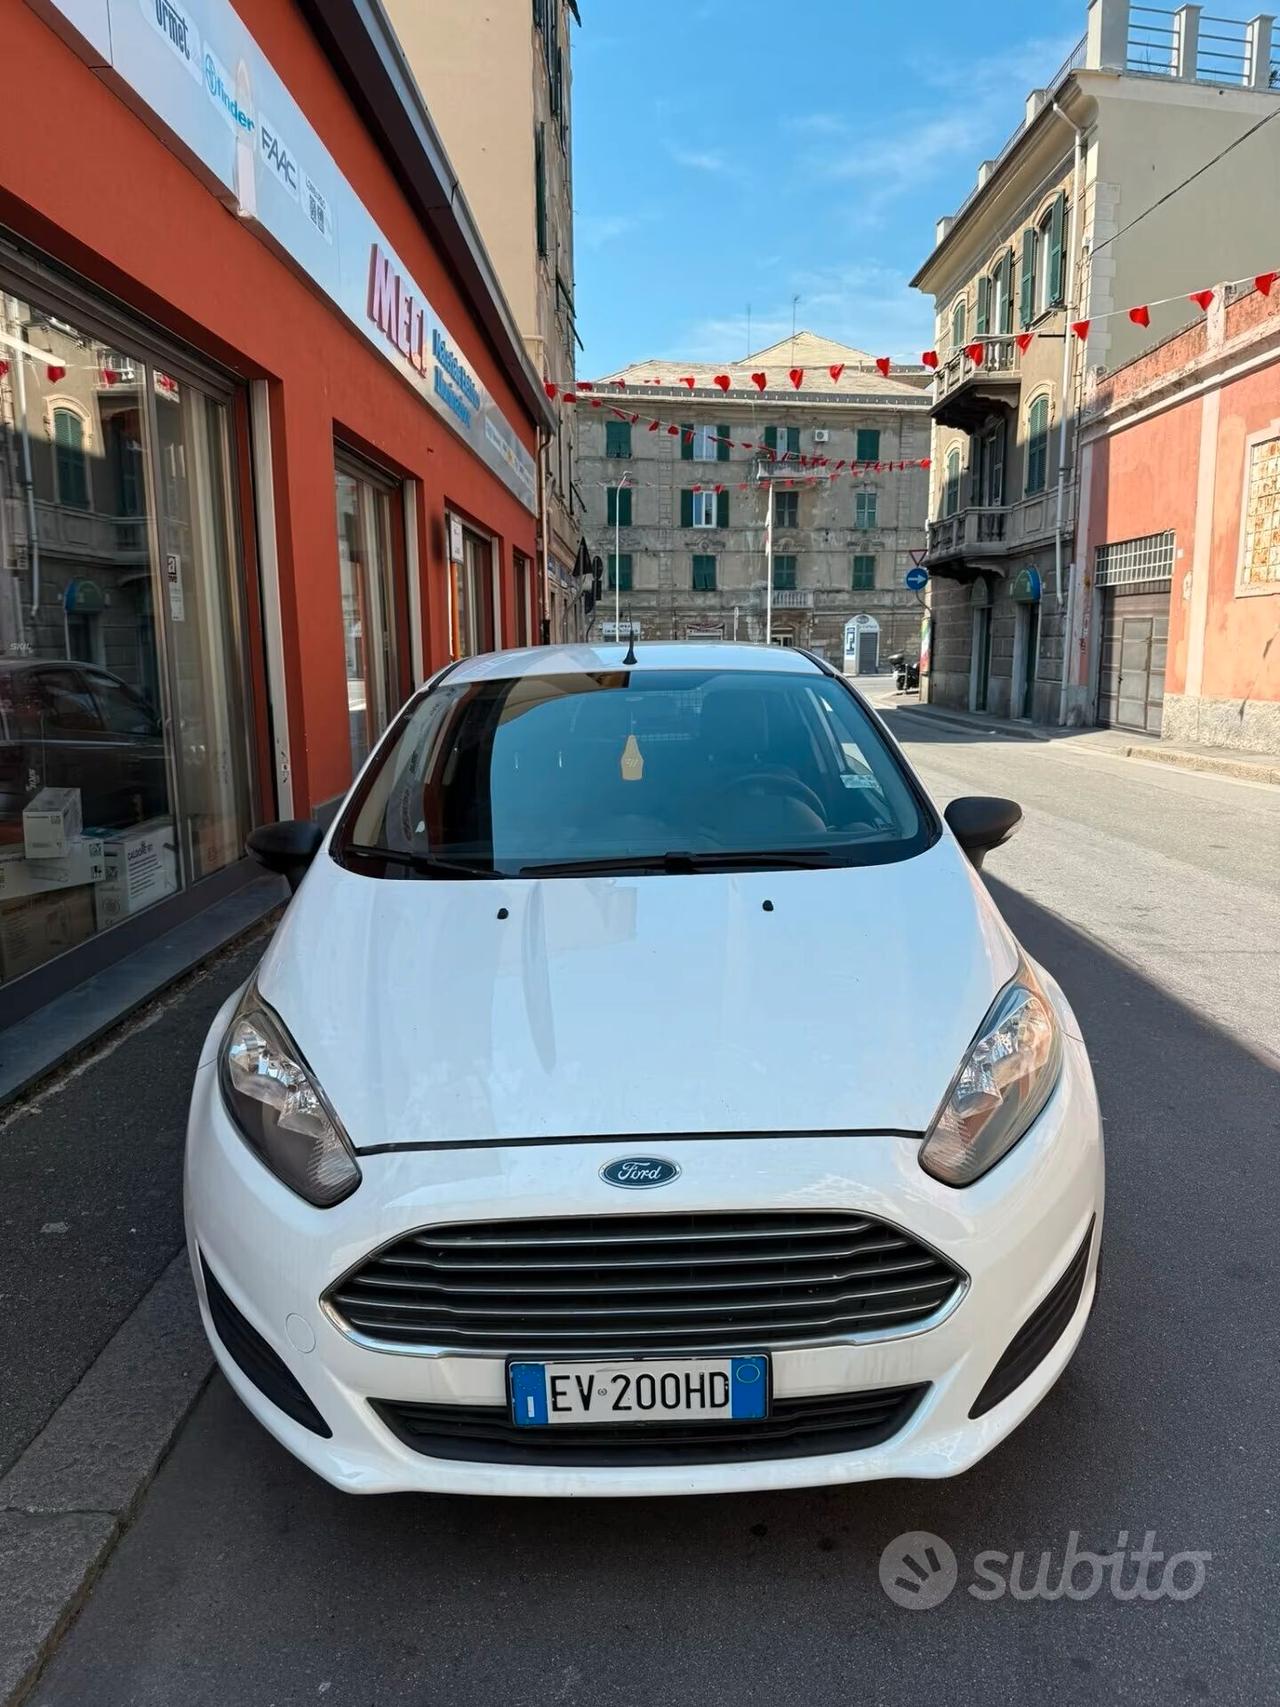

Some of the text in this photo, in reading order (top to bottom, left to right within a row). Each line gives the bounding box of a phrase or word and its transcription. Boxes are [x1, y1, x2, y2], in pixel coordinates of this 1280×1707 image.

[216, 76, 255, 132] finder
[261, 125, 297, 190] FAAC
[617, 1161, 662, 1181] Ford
[549, 1371, 730, 1412] EV 200HD
